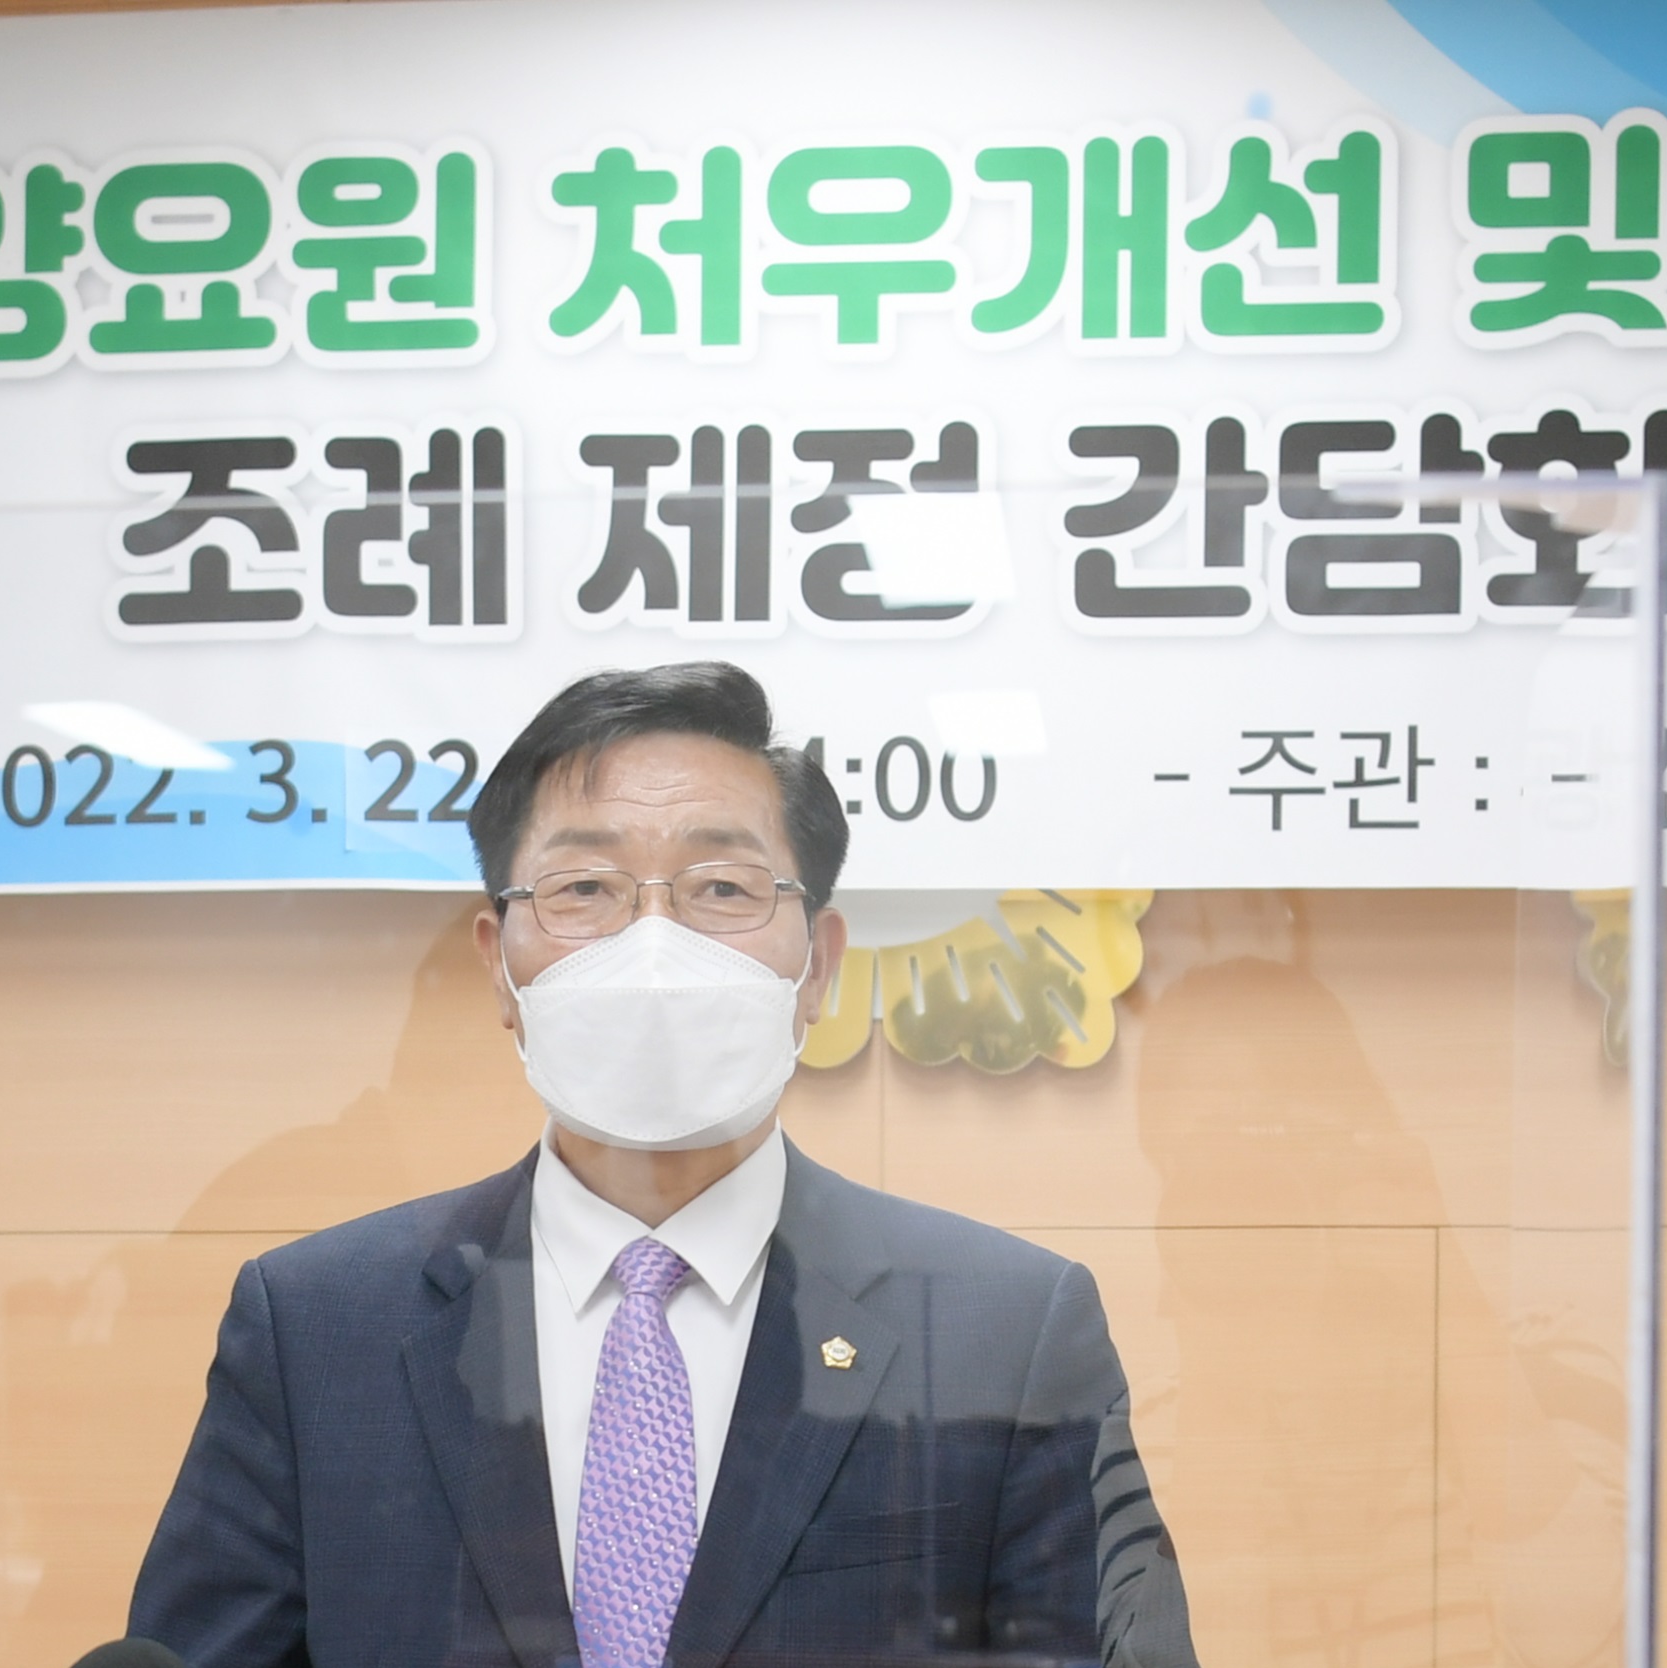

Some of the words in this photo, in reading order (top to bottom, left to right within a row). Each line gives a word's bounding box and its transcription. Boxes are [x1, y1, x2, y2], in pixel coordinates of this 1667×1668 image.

[551, 129, 1385, 346] 처우개선
[1467, 114, 1666, 333] 및
[117, 426, 509, 627] 조례
[576, 420, 980, 623] 제정
[1228, 725, 1436, 831] 주관
